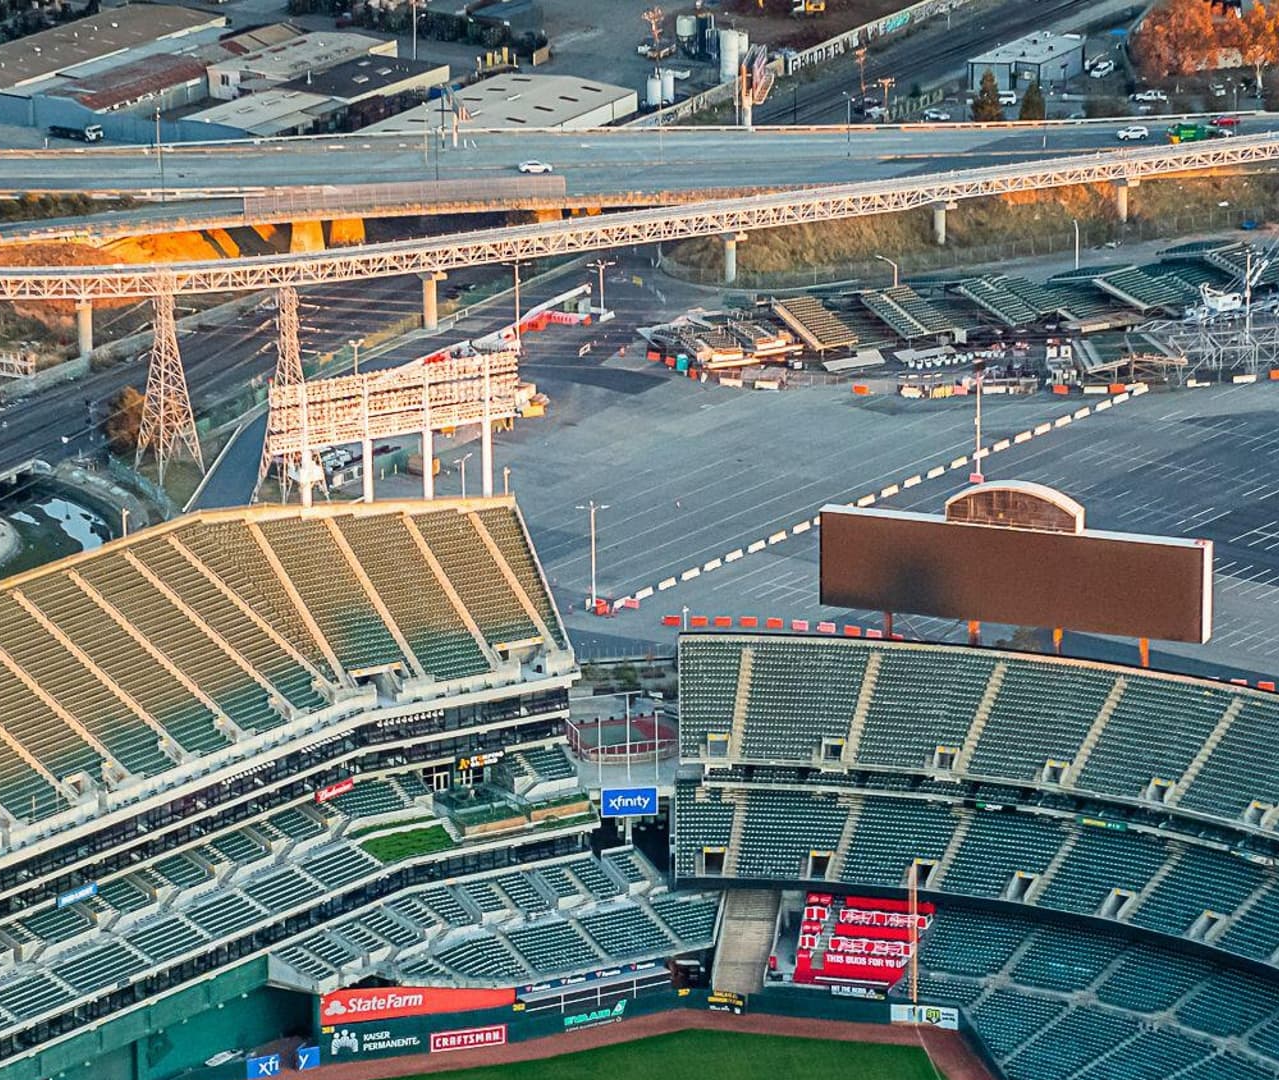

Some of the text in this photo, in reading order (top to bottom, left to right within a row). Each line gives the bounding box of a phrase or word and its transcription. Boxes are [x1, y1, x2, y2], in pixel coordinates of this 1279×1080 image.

[609, 795, 650, 810] xfinity
[363, 1031, 391, 1041] KAISER
[435, 1031, 500, 1048] CRAFTSMAN
